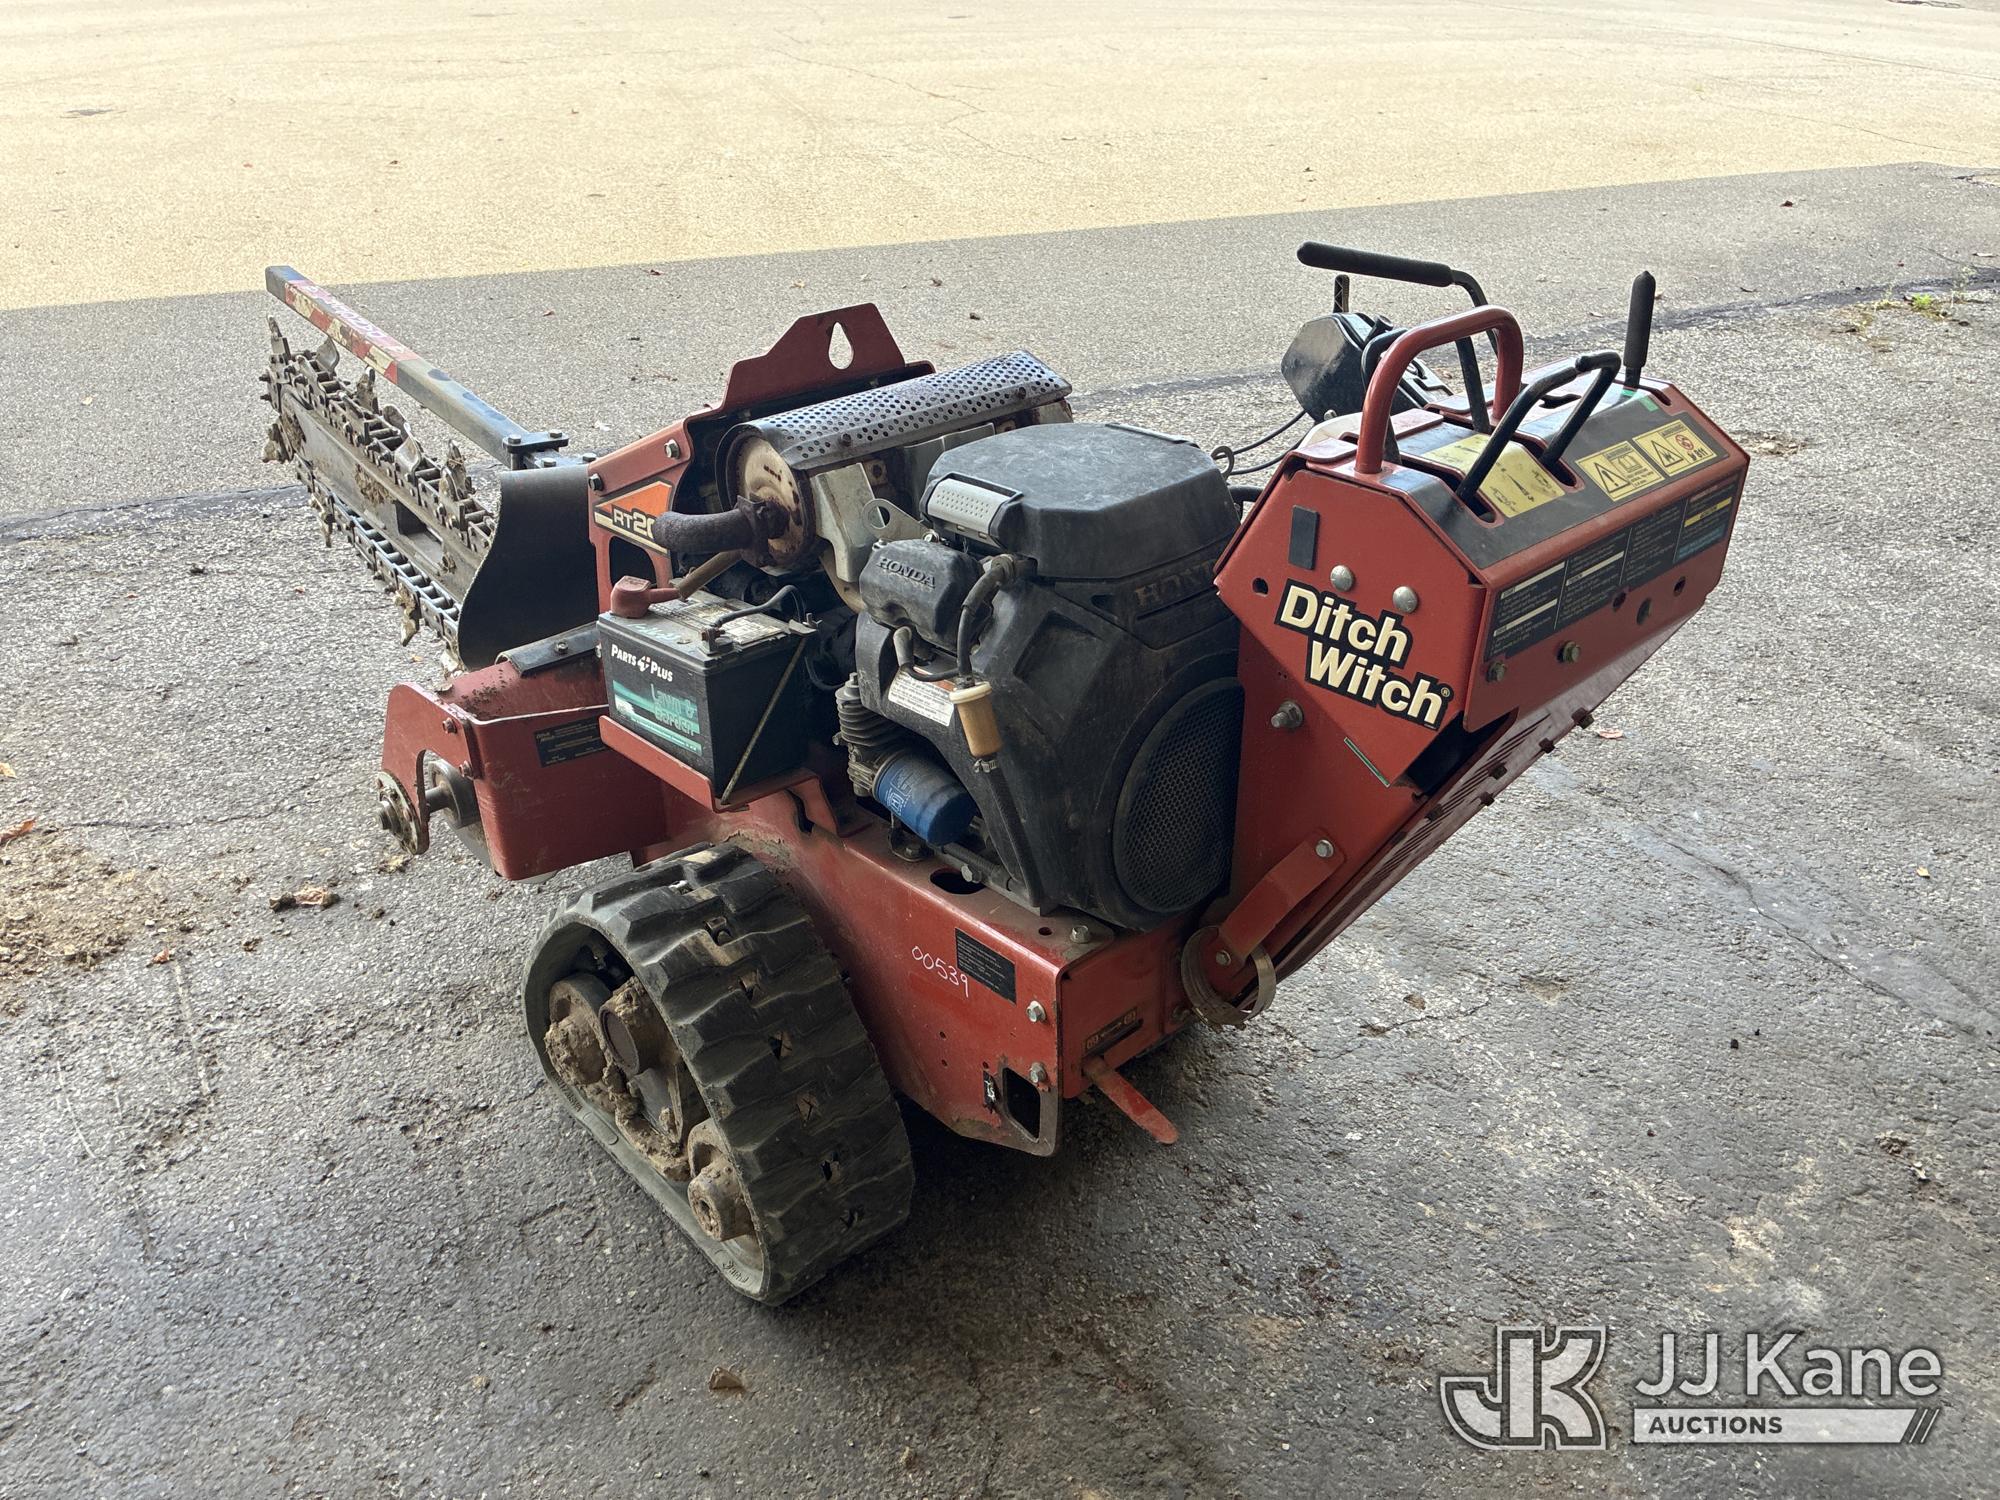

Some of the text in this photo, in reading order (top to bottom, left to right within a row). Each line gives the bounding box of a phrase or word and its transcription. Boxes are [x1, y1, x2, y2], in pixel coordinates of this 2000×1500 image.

[876, 556, 936, 589] HONDA
[1280, 584, 1408, 662] Ditch
[611, 643, 673, 682] PARTS PLUS
[911, 945, 969, 998] 00539
